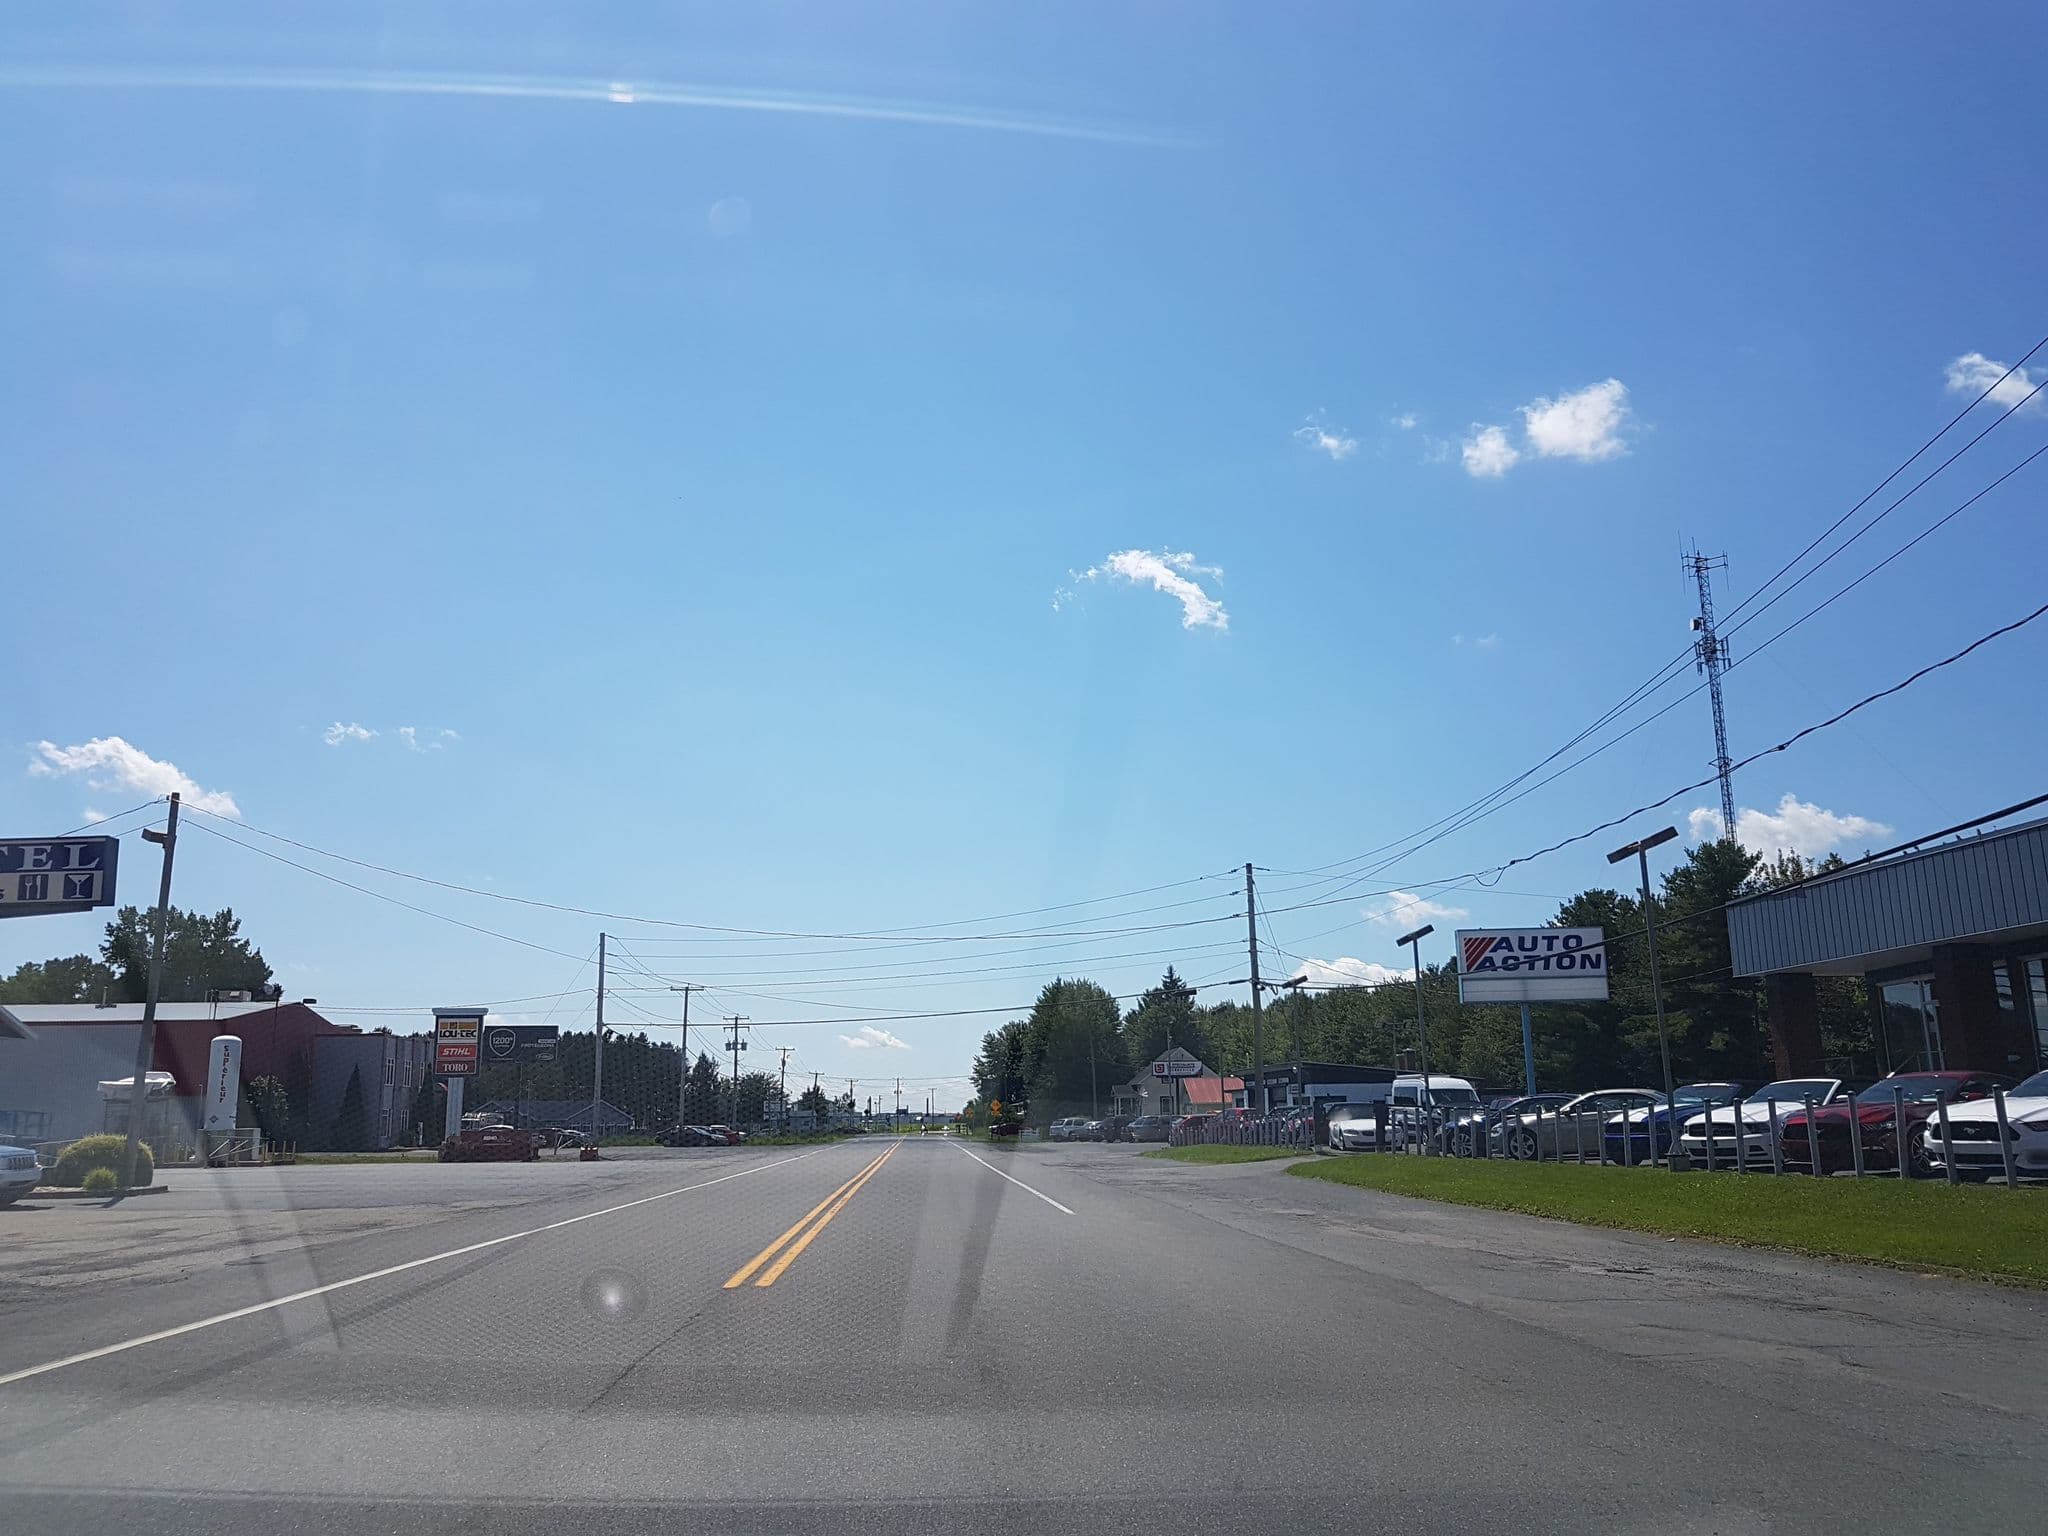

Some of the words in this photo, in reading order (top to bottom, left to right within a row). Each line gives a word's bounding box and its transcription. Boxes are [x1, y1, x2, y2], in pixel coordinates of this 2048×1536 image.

[1489, 934, 1583, 953] AUTO
[1474, 953, 1602, 972] ACTION
[442, 1047, 471, 1056] STIHL
[442, 1063, 468, 1072] TORO
